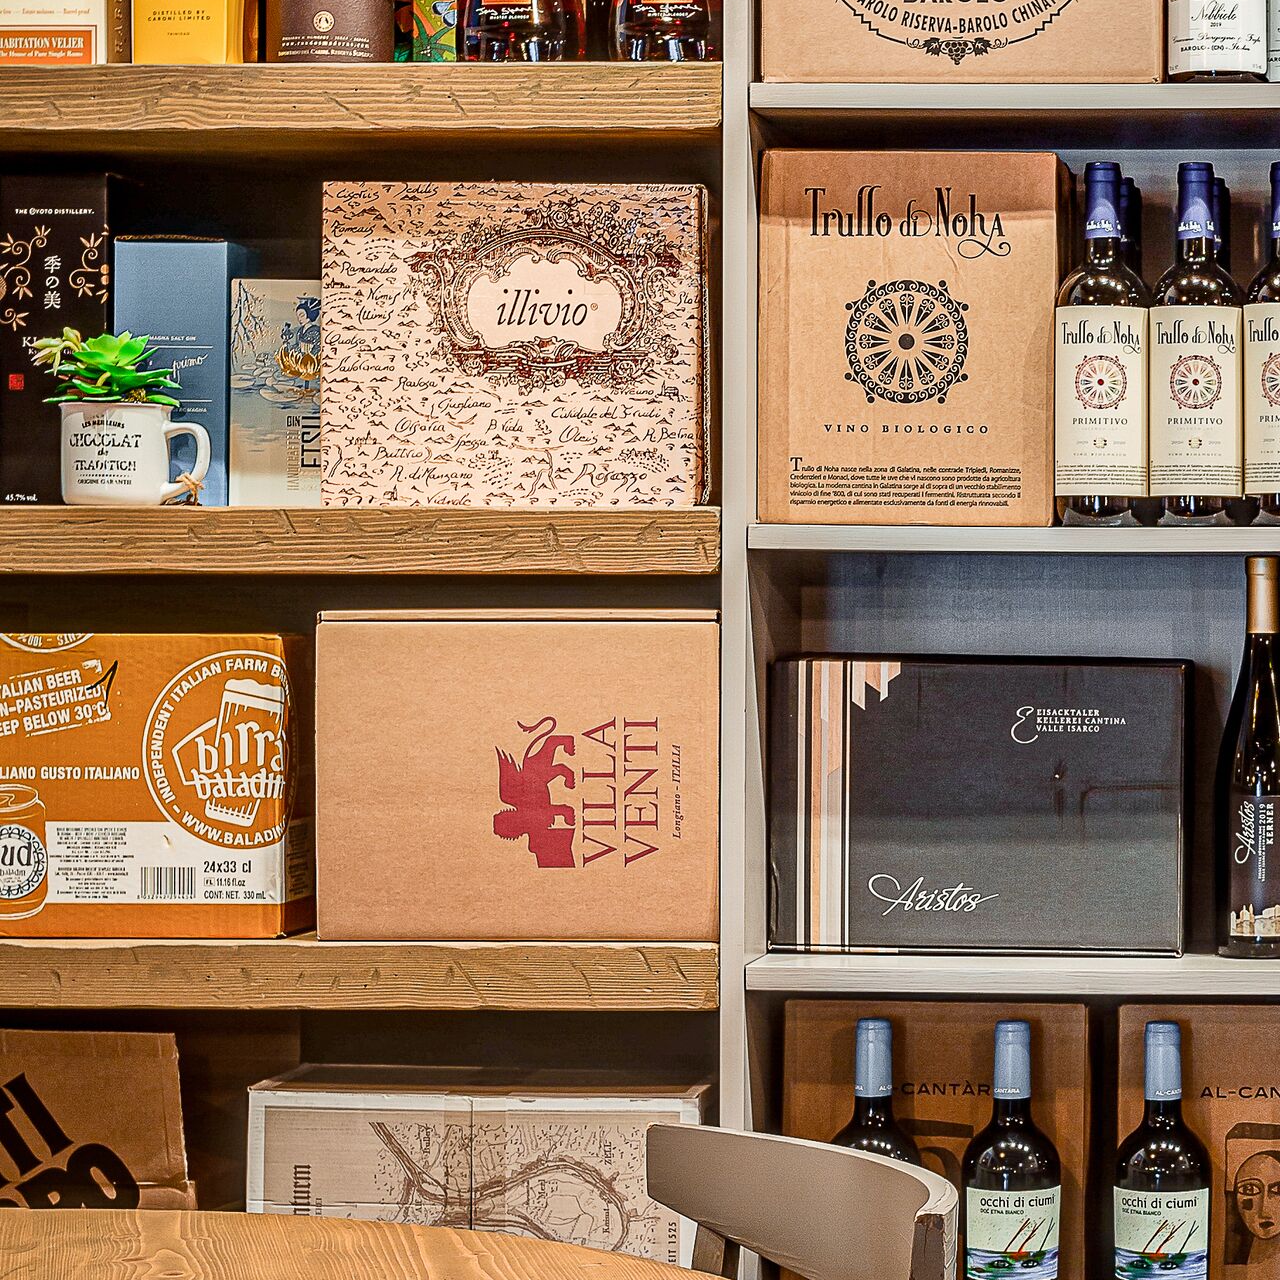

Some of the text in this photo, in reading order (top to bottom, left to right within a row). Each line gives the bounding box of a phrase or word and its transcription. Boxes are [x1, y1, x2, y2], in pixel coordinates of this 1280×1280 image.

[1191, 1, 1238, 21] Nebbiolo
[901, 11, 1009, 34] RISERVA-BAROLO
[804, 185, 893, 238] Trullo
[899, 200, 932, 238] di
[43, 255, 62, 310] 季の美
[496, 288, 589, 327] illivio
[1061, 320, 1094, 345] Trullo
[824, 424, 989, 434] VINO BIOLOGICO
[1072, 418, 1128, 426] PRIMITIVO
[69, 433, 142, 448] CHOCOLAT
[73, 459, 136, 472] TRADITION
[46, 669, 82, 689] BEER
[24, 710, 70, 732] BELOW
[1036, 708, 1100, 717] EISACKTALER
[1036, 717, 1127, 725] KELLEREI CANTINA
[150, 658, 267, 804] INDEPENDENT ITALIAN FARM
[1067, 725, 1100, 733] ISARCO
[40, 767, 140, 780] GUSTO ITALIANO
[581, 717, 617, 868] VILLA
[624, 717, 659, 868] VENTI
[672, 744, 684, 839] Longiano ITALIA
[1234, 801, 1256, 865] Aristos
[1266, 803, 1274, 845] KERNER
[203, 860, 237, 873] 24x33
[868, 873, 999, 916] Aristos
[980, 1193, 1055, 1208] occhi di ciumi
